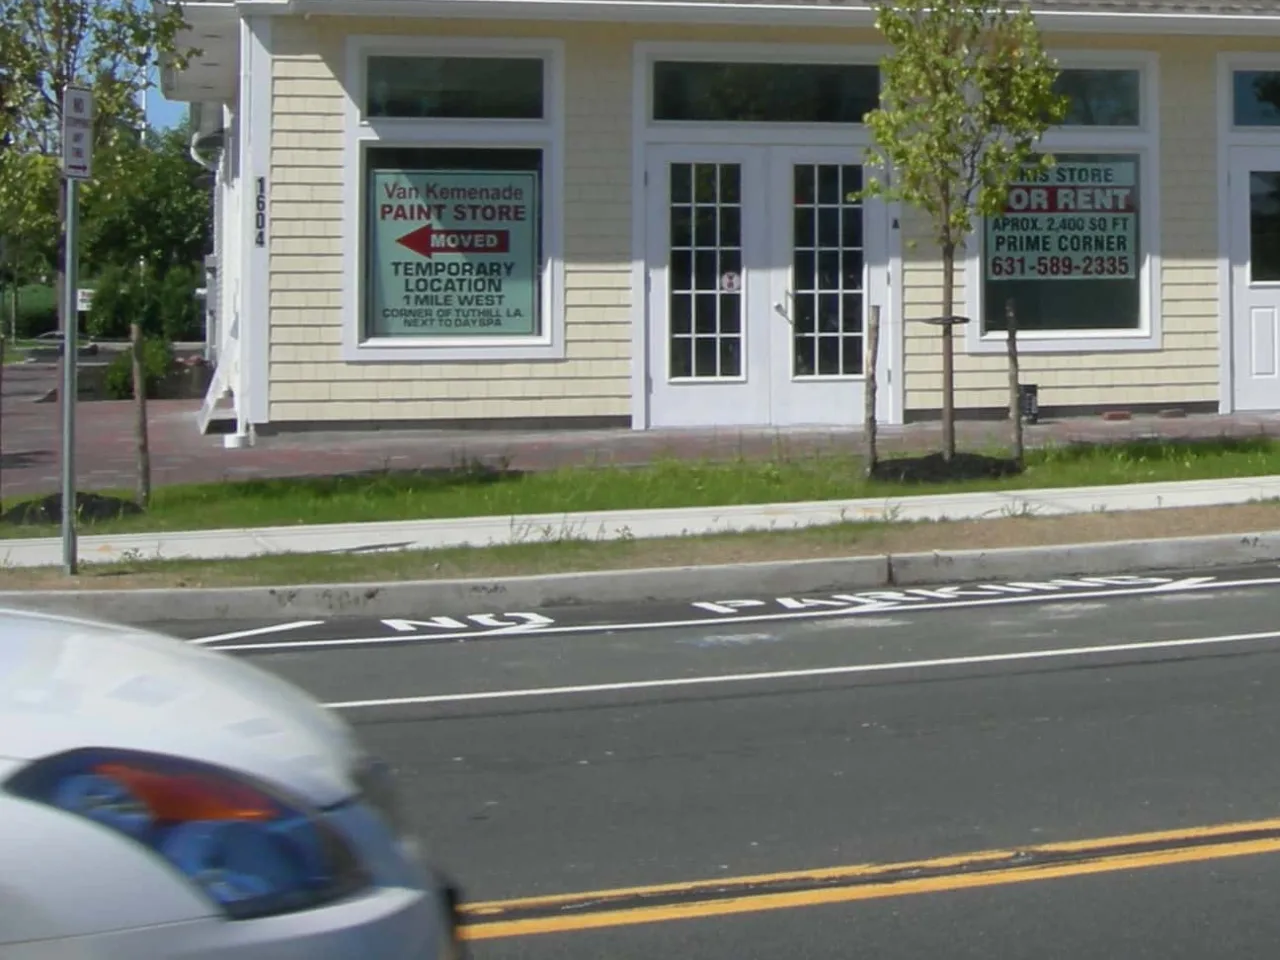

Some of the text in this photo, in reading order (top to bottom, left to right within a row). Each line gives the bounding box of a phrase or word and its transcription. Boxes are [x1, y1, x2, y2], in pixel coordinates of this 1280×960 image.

[1017, 167, 1114, 183] HIS STORE
[384, 182, 524, 200] Van Kemenade
[1008, 188, 1131, 210] OR RENT
[255, 176, 265, 247] 1604
[380, 204, 526, 221] PAINT STORE
[992, 217, 1043, 231] APROX.
[1088, 217, 1107, 231] SQ
[1112, 217, 1129, 231] FT
[430, 234, 498, 248] MOVED
[995, 236, 1128, 252] PRIME CORNER
[391, 262, 515, 277] TEMPORARY
[991, 256, 1130, 275] 631-589-2335
[404, 278, 503, 292] LOCATION
[402, 295, 505, 306] 1 MILE WEST
[382, 308, 433, 318] CORNER
[436, 308, 451, 318] OF
[454, 308, 502, 318] TUTHILL
[403, 318, 434, 328] NEXT
[439, 318, 451, 328] TO
[380, 611, 556, 632] NO
[692, 575, 1174, 613] PARKING
